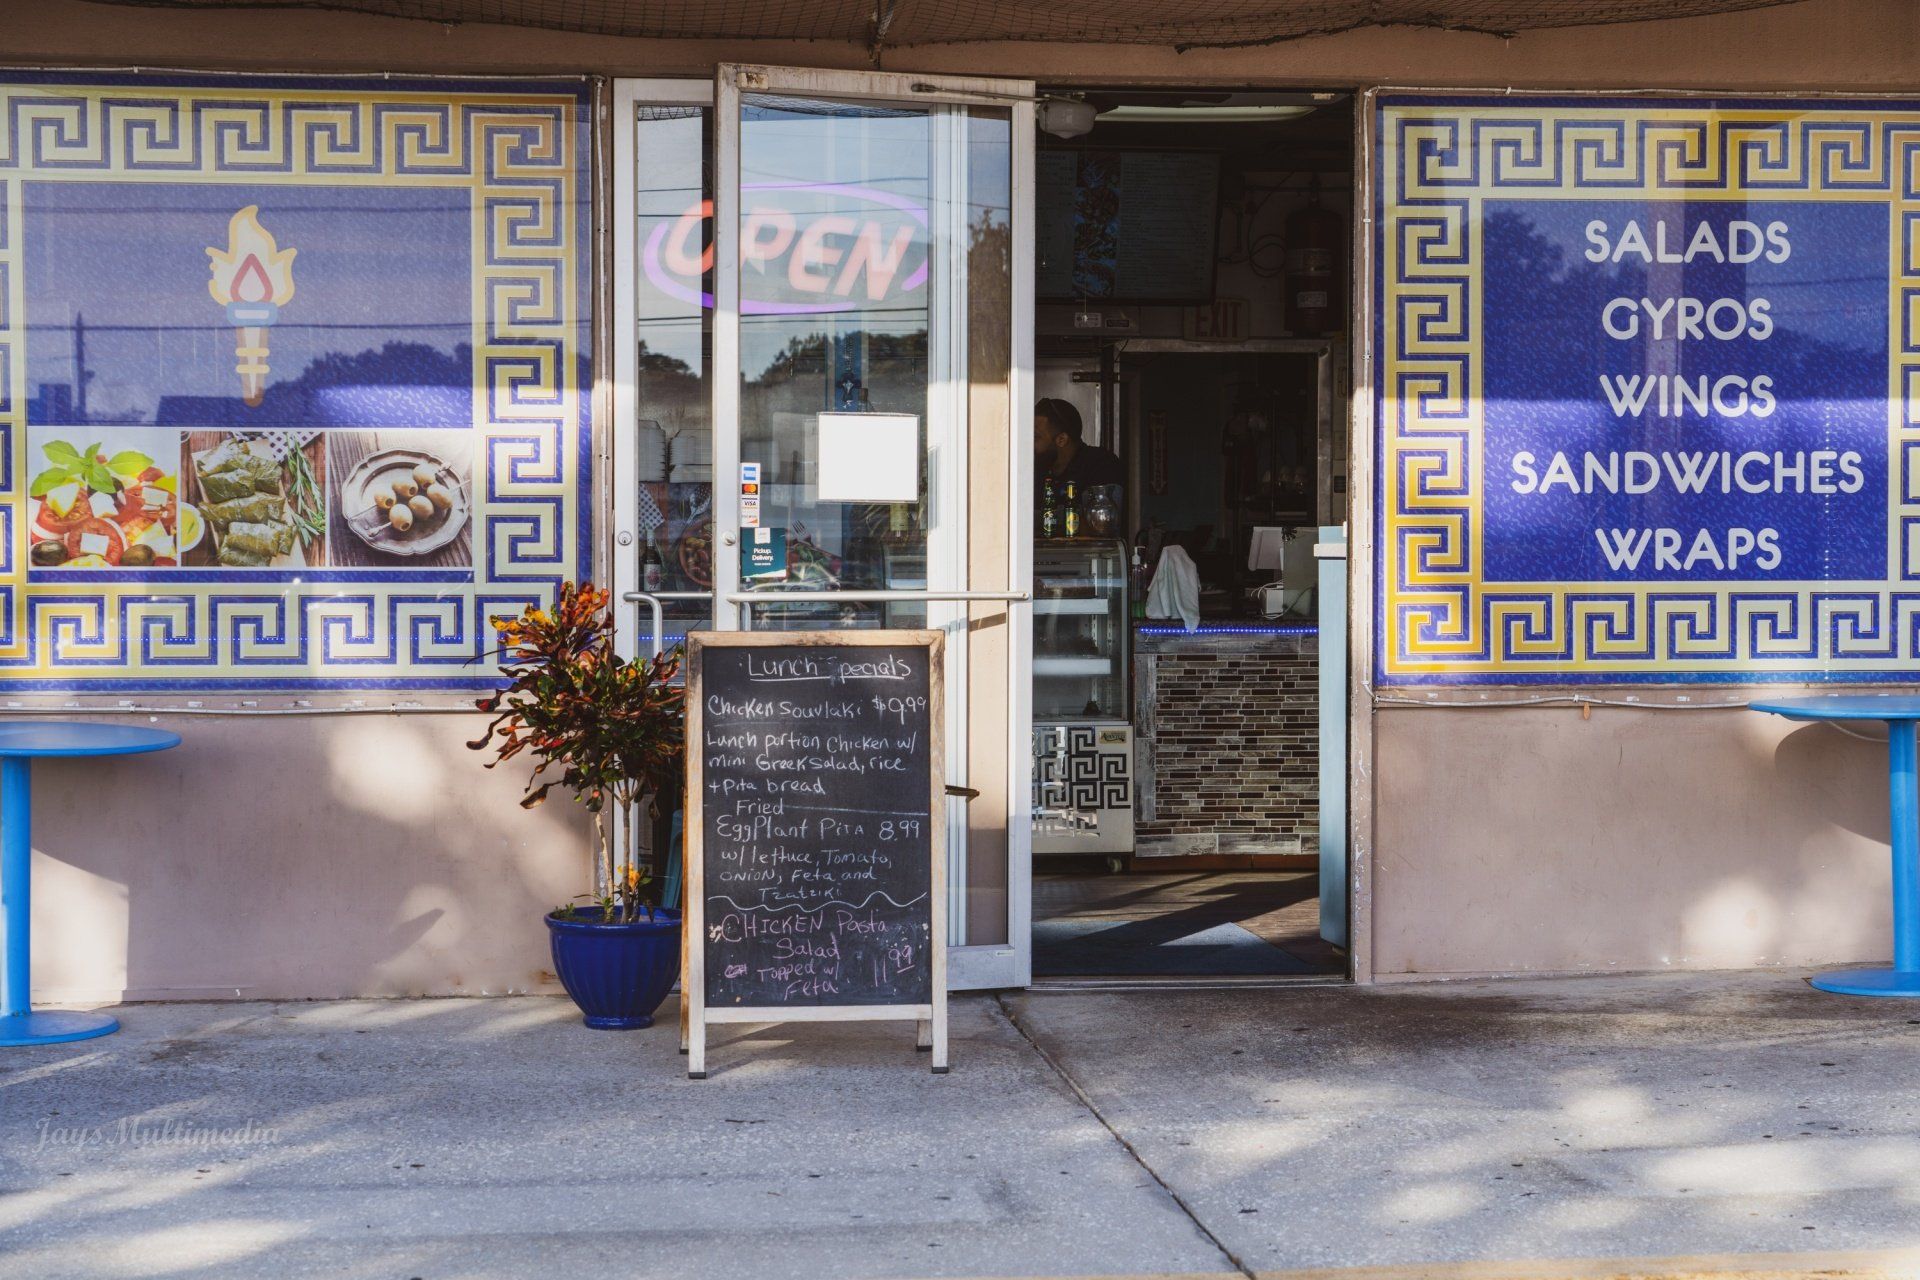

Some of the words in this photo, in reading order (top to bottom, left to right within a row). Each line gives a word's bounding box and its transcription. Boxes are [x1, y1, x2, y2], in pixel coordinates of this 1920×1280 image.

[666, 199, 915, 301] OPEN
[1584, 220, 1792, 264] SALADS
[1195, 302, 1241, 337] EXIT
[1601, 297, 1774, 341] GYROS
[1599, 374, 1777, 418] WINGS
[1512, 451, 1865, 494] SANDWICHES
[1595, 528, 1782, 571] WRAPS
[748, 653, 818, 677] Lunch
[872, 694, 927, 725] $9.99
[707, 731, 757, 748] Lunch
[765, 731, 820, 757] portion
[827, 736, 889, 753] Chicken
[897, 731, 916, 754] w/
[869, 757, 906, 771] rice
[767, 777, 826, 795] bread
[736, 798, 784, 815] Fried
[878, 820, 920, 841] 8.99
[721, 846, 745, 866] w/
[752, 847, 820, 867] lettuce,
[791, 868, 837, 882] Feta
[841, 867, 878, 880] and
[721, 910, 824, 942] CHICKEN
[837, 909, 888, 936] Pasta
[772, 933, 842, 960] Salad
[823, 961, 840, 980] w/
[784, 979, 840, 1001] Feta
